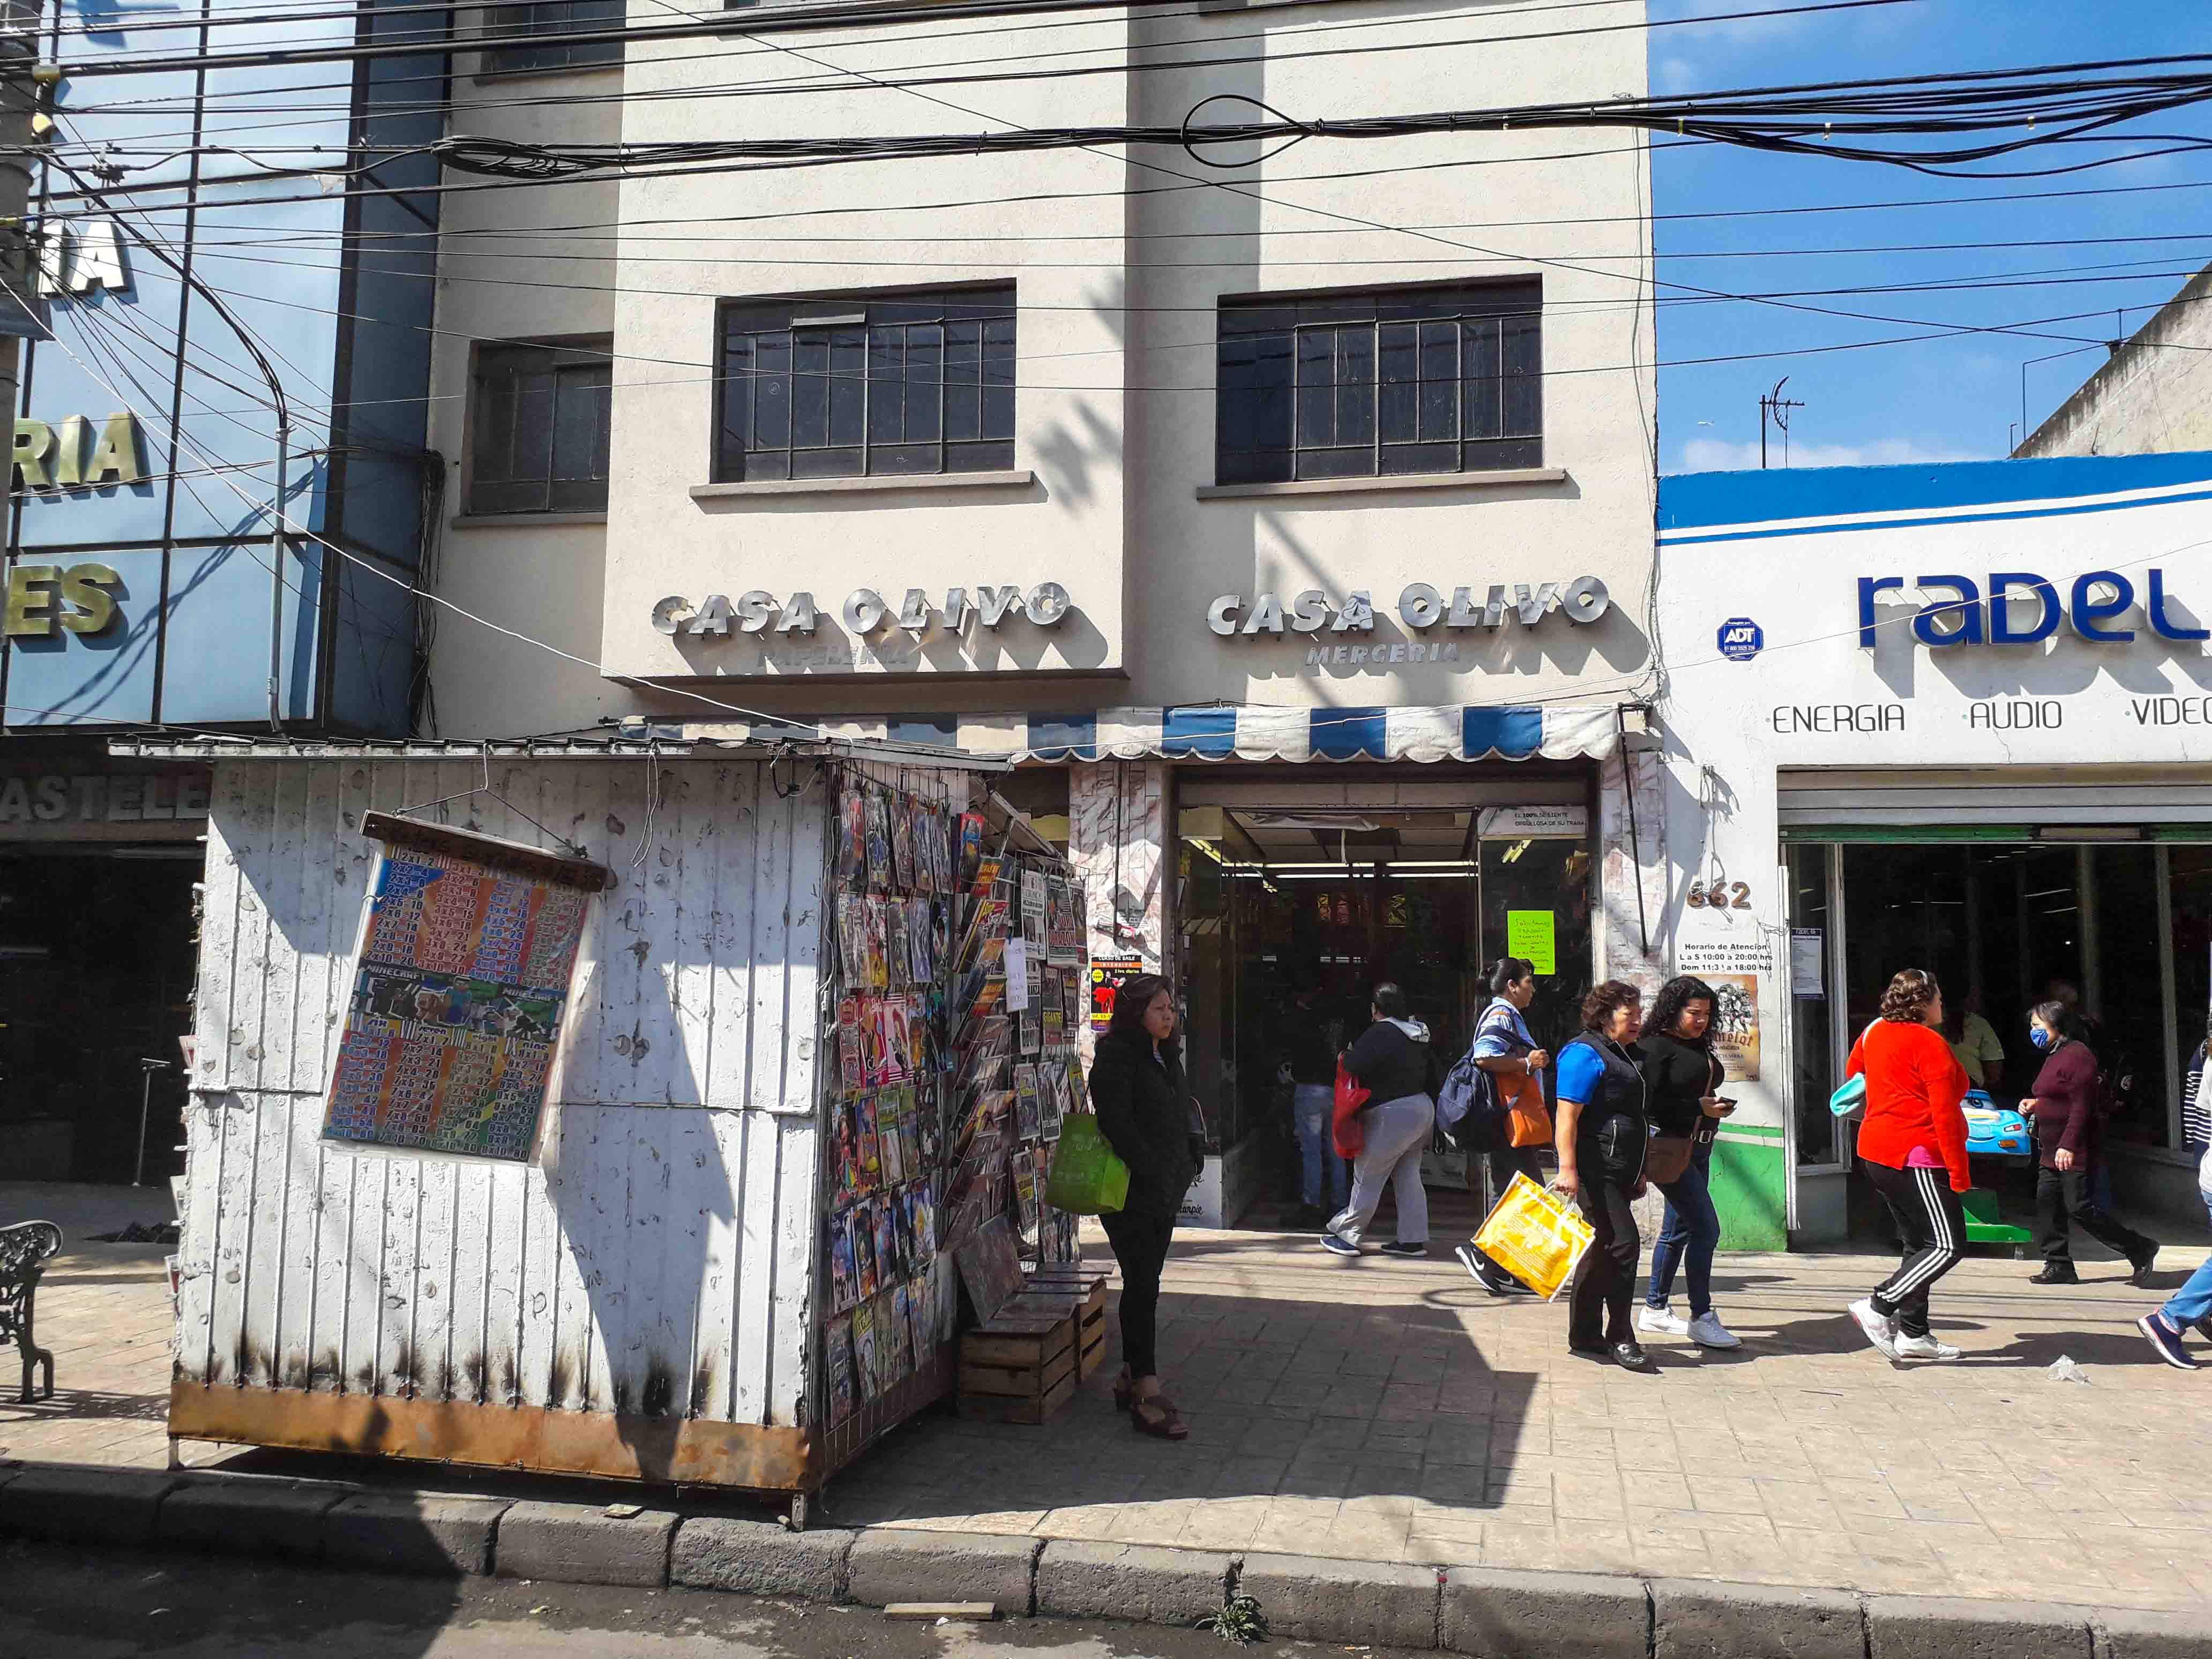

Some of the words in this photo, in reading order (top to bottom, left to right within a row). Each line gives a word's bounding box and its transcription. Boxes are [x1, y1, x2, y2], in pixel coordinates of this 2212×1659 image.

[12, 412, 139, 485] RIA
[651, 591, 815, 637] CASA
[842, 581, 1071, 634] OLIVO
[1207, 589, 1373, 636] CASA
[1398, 575, 1609, 629] OLIVO
[1724, 628, 1755, 643] ADT
[757, 644, 909, 668] PAPELERIA
[1305, 641, 1460, 666] MERCERIA
[1773, 704, 1905, 734] ENERGIA
[1970, 701, 2062, 729] AUDIO
[1686, 880, 1752, 909] 662
